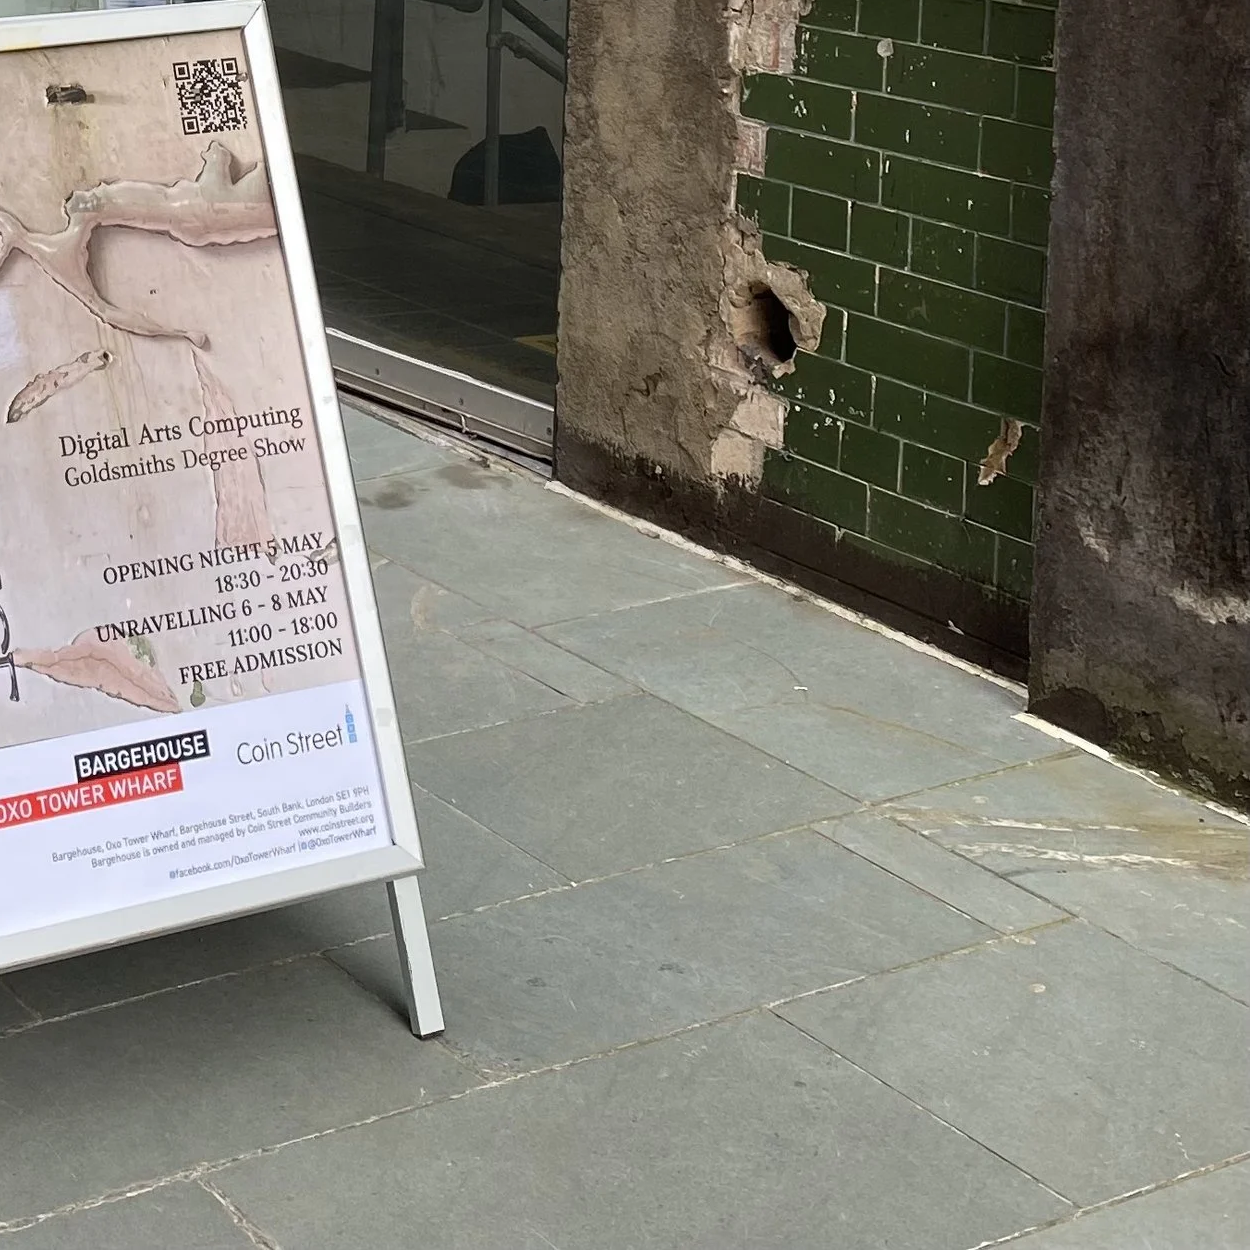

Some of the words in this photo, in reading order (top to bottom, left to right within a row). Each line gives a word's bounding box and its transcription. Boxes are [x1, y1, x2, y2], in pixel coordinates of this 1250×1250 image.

[59, 427, 130, 460] Digital
[138, 423, 182, 445] Arts
[188, 406, 303, 438] Computing
[64, 455, 175, 487] Goldsmiths
[181, 447, 248, 471] Degree
[253, 437, 306, 459] Show
[103, 555, 194, 585] OPENING
[199, 542, 262, 569] NIGHT
[267, 540, 278, 557] 5
[281, 532, 324, 555] MAY
[214, 570, 261, 594] 18:30
[280, 558, 329, 582] 20:30
[94, 602, 237, 643] UNRAVELLING
[241, 599, 252, 617] 6
[271, 593, 282, 611] 8
[286, 586, 328, 609] MAY
[227, 623, 273, 647] 11:00
[292, 611, 338, 636] 18:00
[179, 659, 228, 685] FREE
[233, 638, 343, 675] ADMISSION
[78, 735, 207, 778] BARGEHOUSE
[236, 737, 283, 766] Coin
[288, 725, 344, 755] Street
[36, 783, 106, 814] TOWER
[108, 769, 180, 801] WHARF
[52, 844, 104, 863] Bargehouse,
[105, 840, 122, 851] Oxo
[122, 834, 150, 847] Tower
[150, 827, 178, 841] Wharf,
[179, 817, 227, 835] Bargehouse
[228, 811, 256, 824] Street,
[257, 805, 281, 818] South
[282, 801, 304, 814] Bank,
[306, 794, 335, 808] London
[335, 790, 351, 801] SE1
[353, 785, 370, 798] 9PH
[91, 849, 141, 868] Bargehouse
[143, 846, 151, 858] is
[152, 840, 179, 855] owned
[181, 836, 196, 849] and
[198, 830, 235, 845] managed
[236, 827, 246, 838] by
[247, 822, 266, 834] Coin
[267, 816, 292, 831] Street
[293, 806, 338, 824] Community
[339, 799, 372, 814] Builders
[298, 813, 375, 837] www.coinstreet.org
